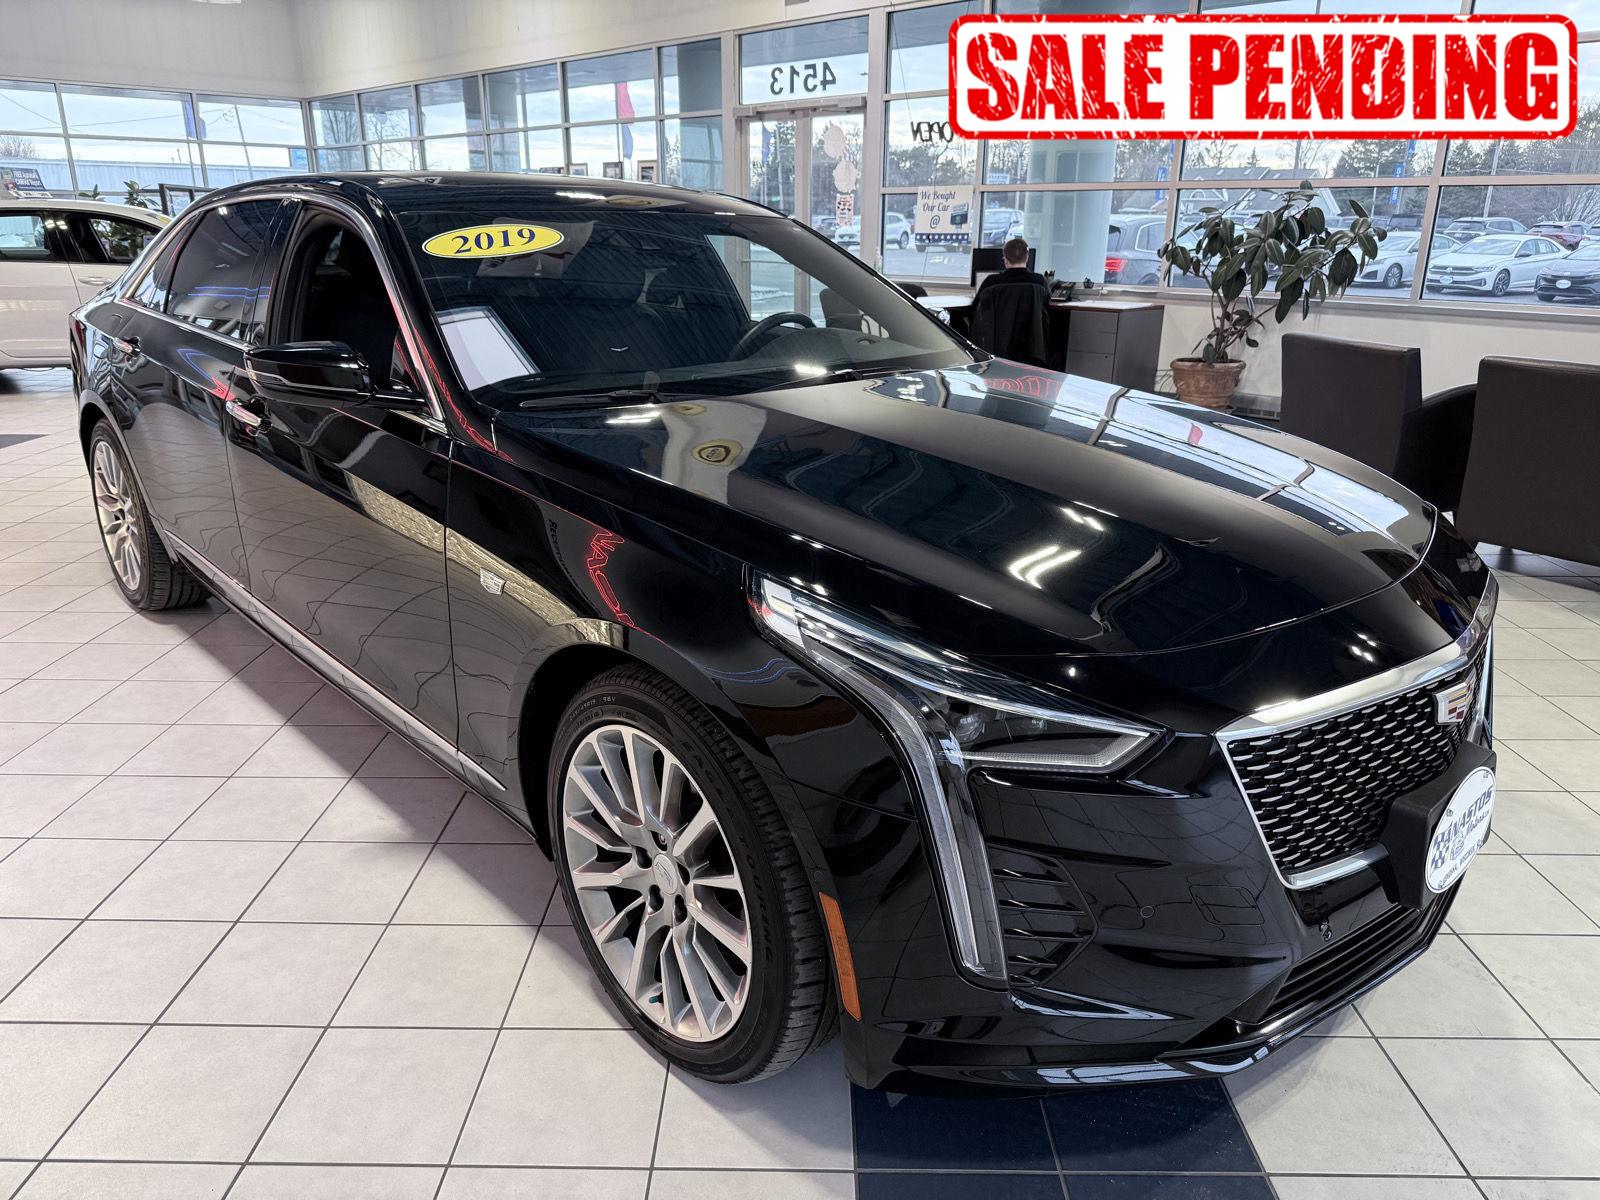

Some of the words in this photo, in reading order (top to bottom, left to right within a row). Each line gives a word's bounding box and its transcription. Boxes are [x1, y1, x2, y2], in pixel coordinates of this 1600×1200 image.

[921, 190, 930, 200] We
[933, 191, 956, 203] Bought
[923, 202, 936, 212] Our
[937, 202, 950, 212] Car
[451, 228, 536, 254] 2019
